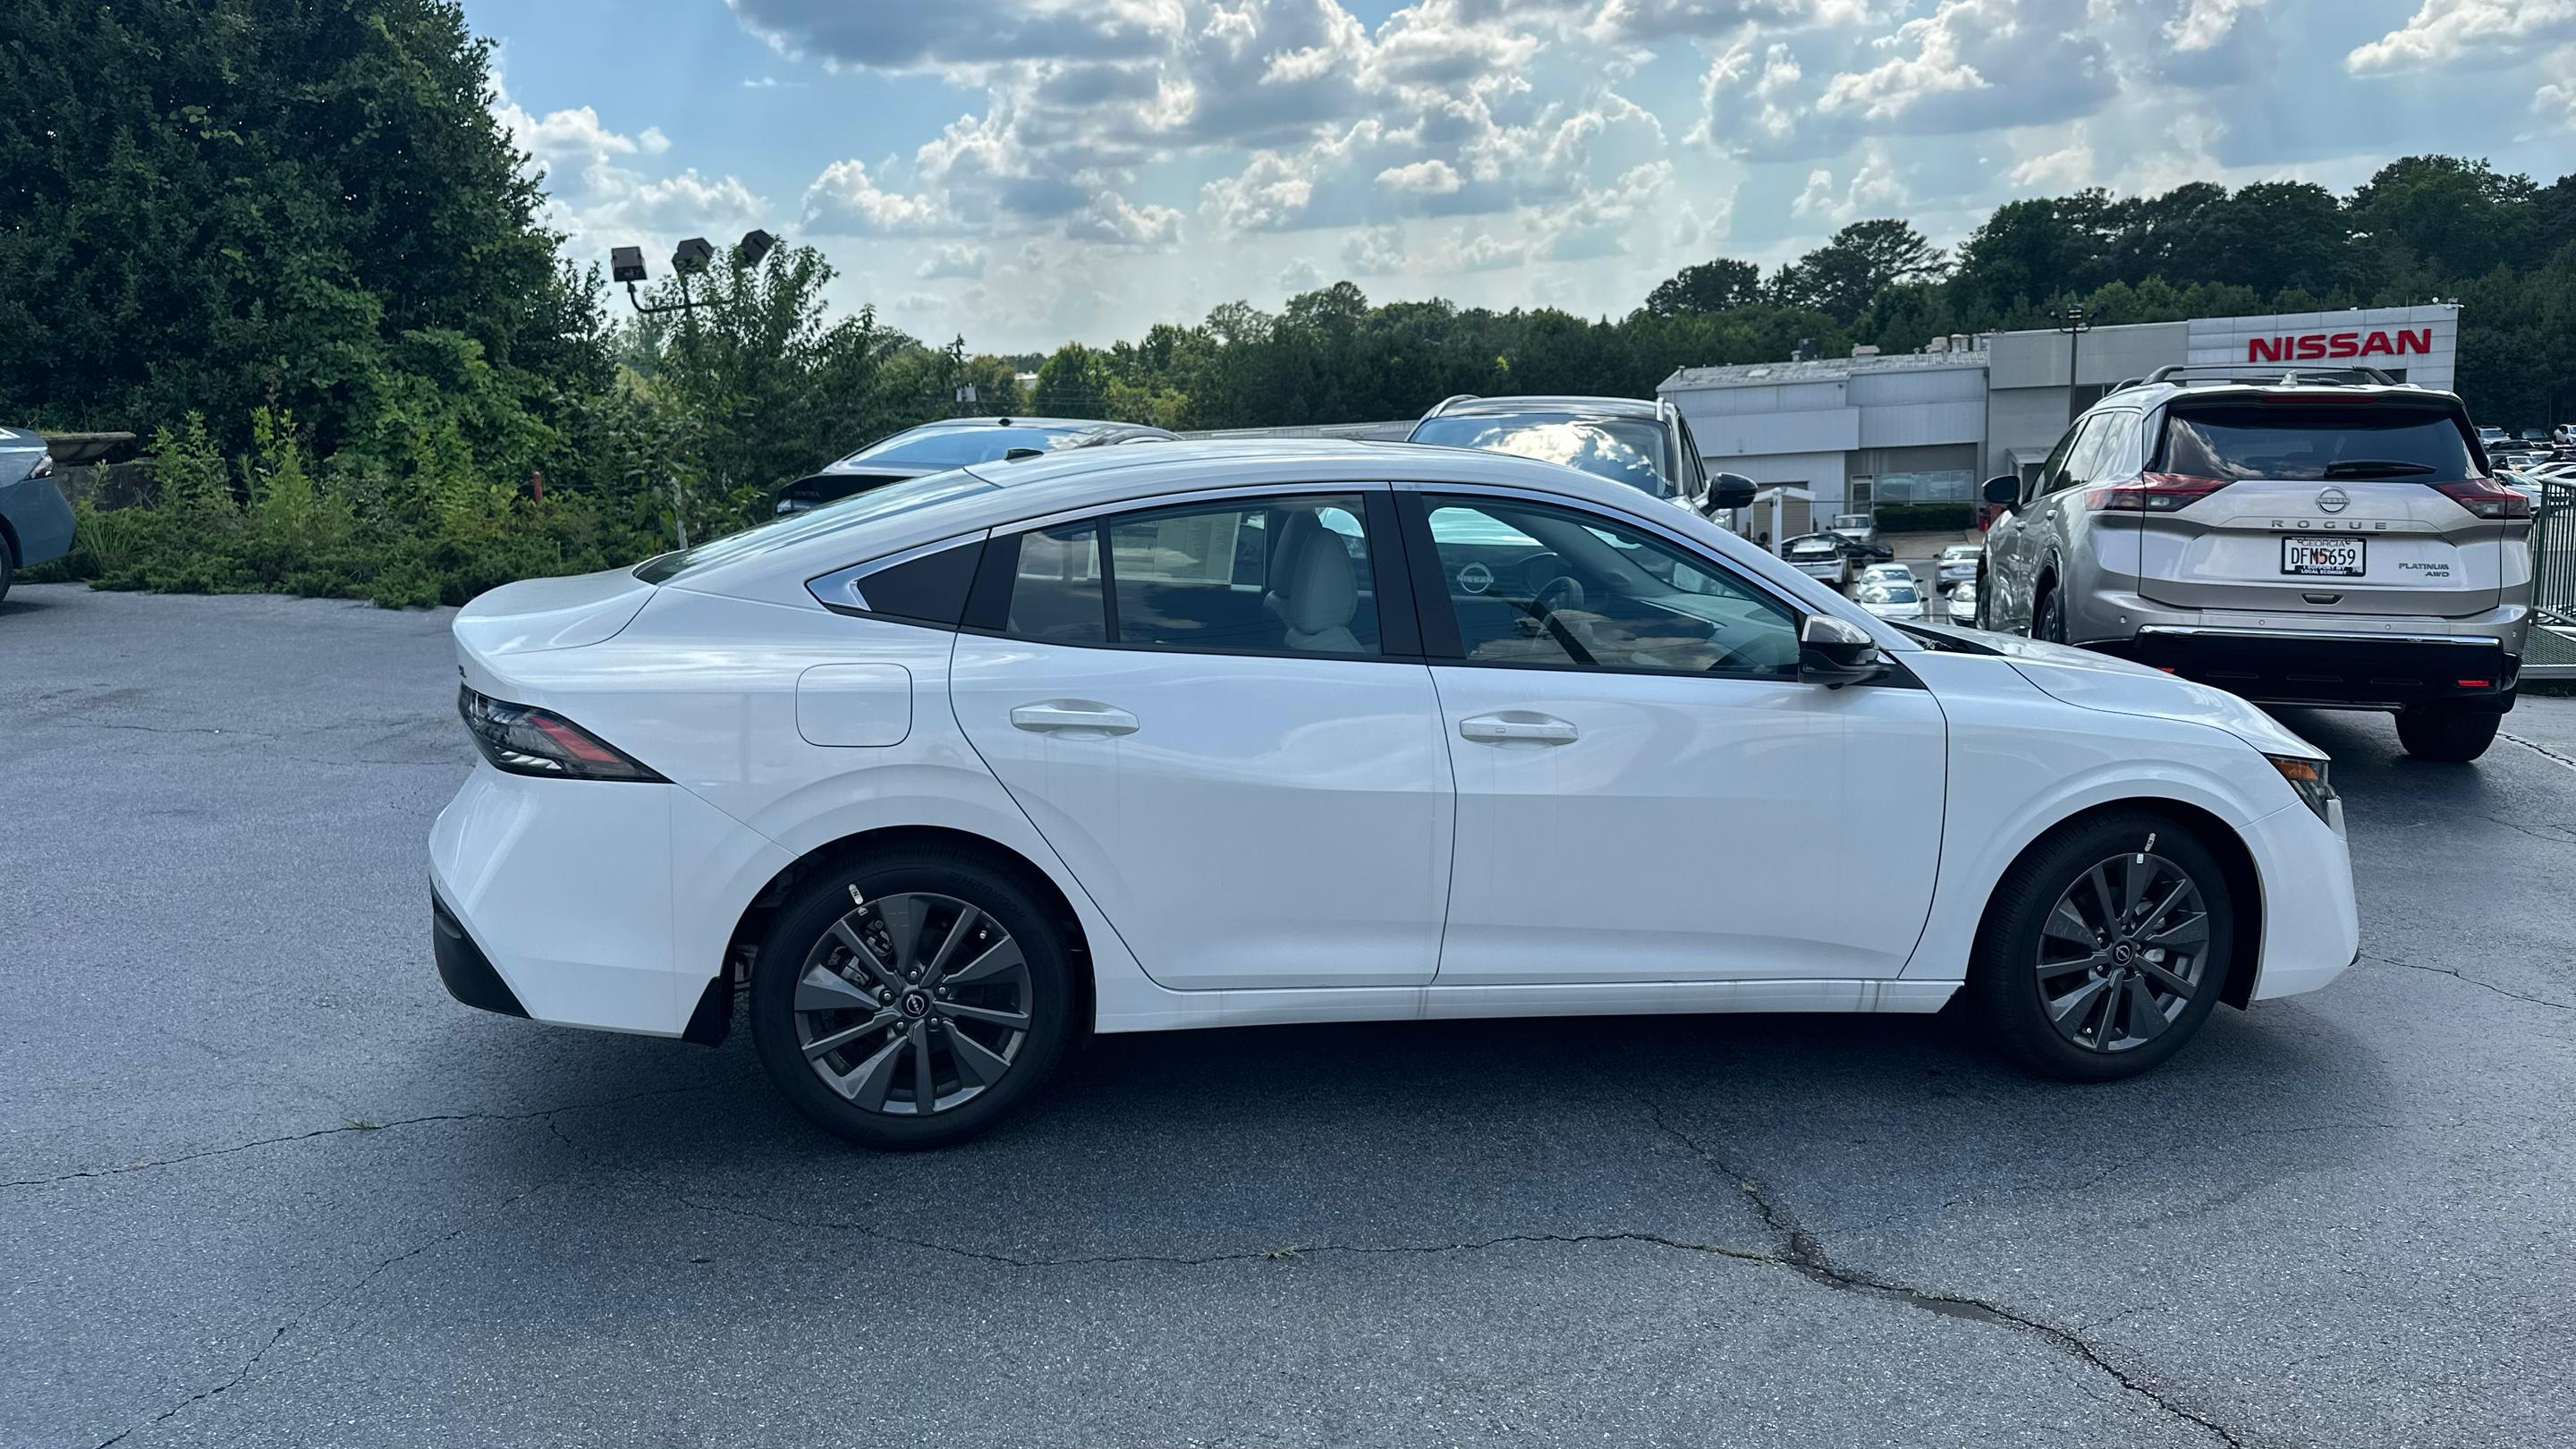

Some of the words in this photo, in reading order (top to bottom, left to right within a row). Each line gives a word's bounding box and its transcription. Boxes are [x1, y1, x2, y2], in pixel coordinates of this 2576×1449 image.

[2249, 328, 2432, 363] NISSAN
[2271, 520, 2387, 530] ROGUE
[2301, 539, 2346, 547] GEORGIA
[2291, 547, 2356, 565] DFM5659
[2398, 563, 2450, 571] PLATINUM
